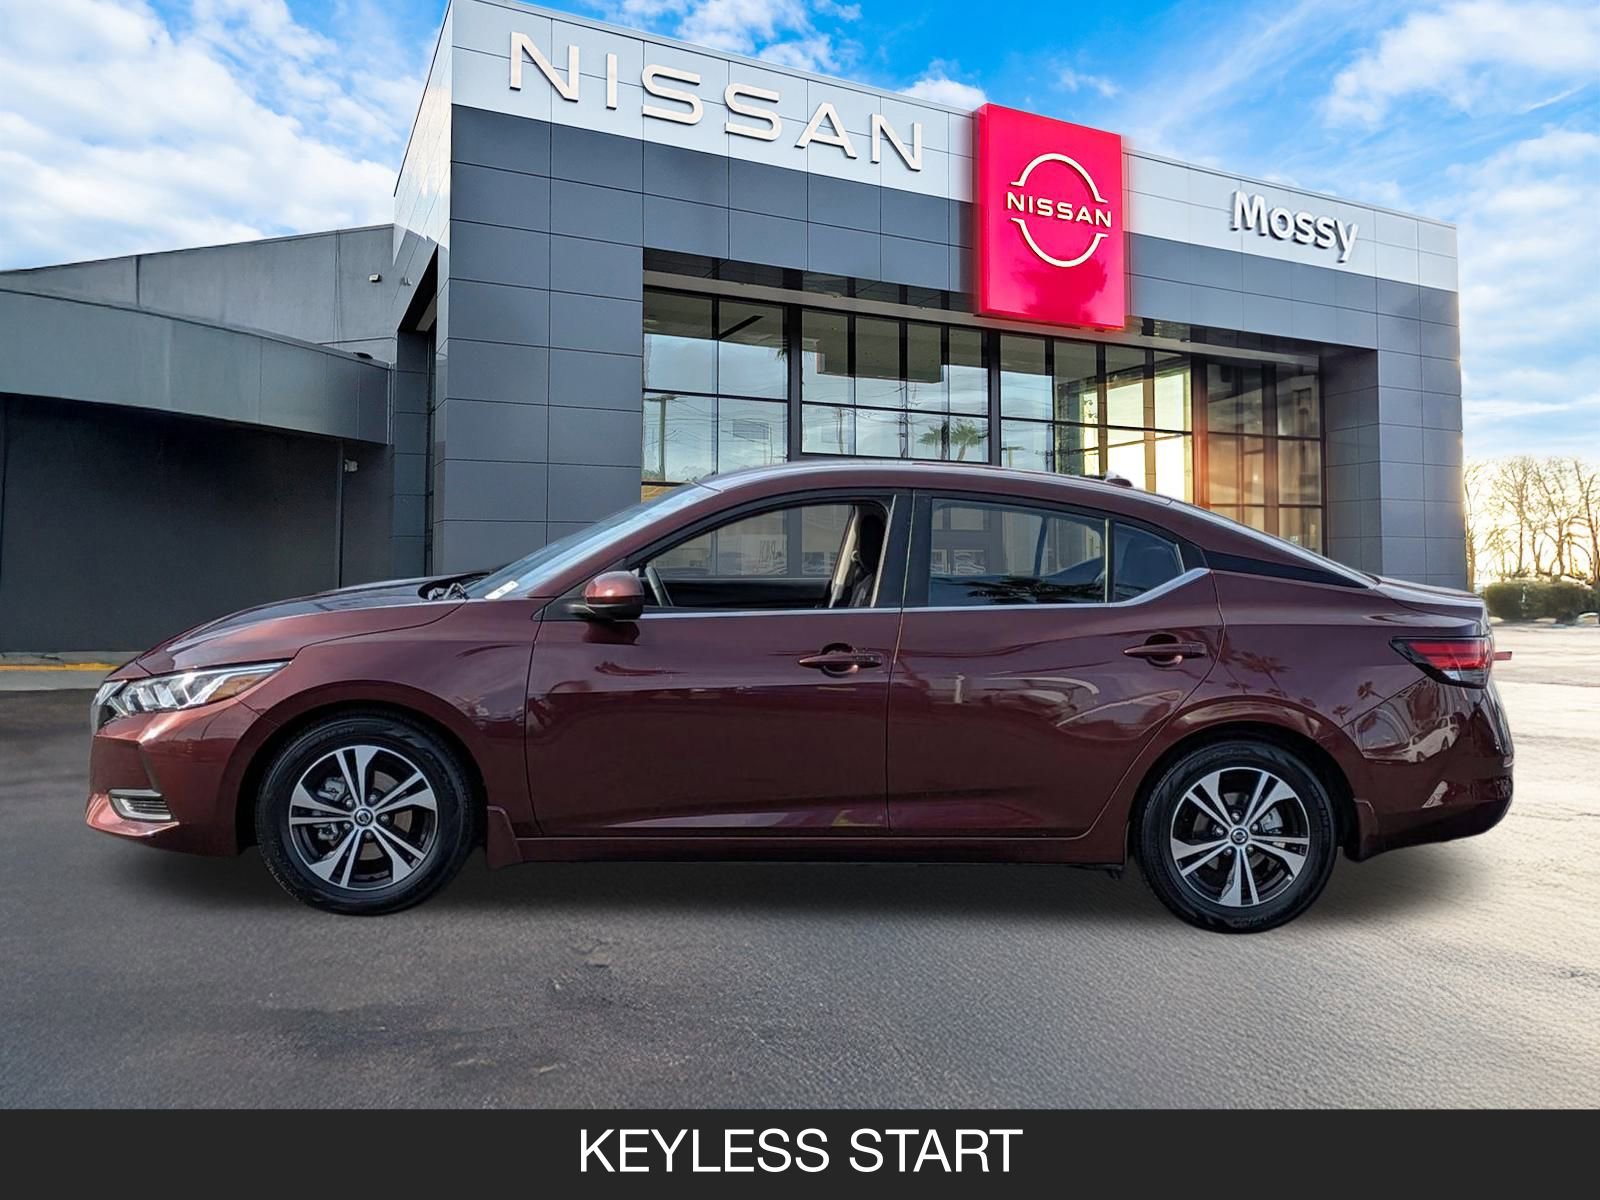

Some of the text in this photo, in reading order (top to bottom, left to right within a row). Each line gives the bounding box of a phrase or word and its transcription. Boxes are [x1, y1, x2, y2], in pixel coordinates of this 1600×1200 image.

[509, 31, 923, 172] NISSAN
[1006, 191, 1112, 228] NISSAN
[1230, 190, 1359, 263] Mossy
